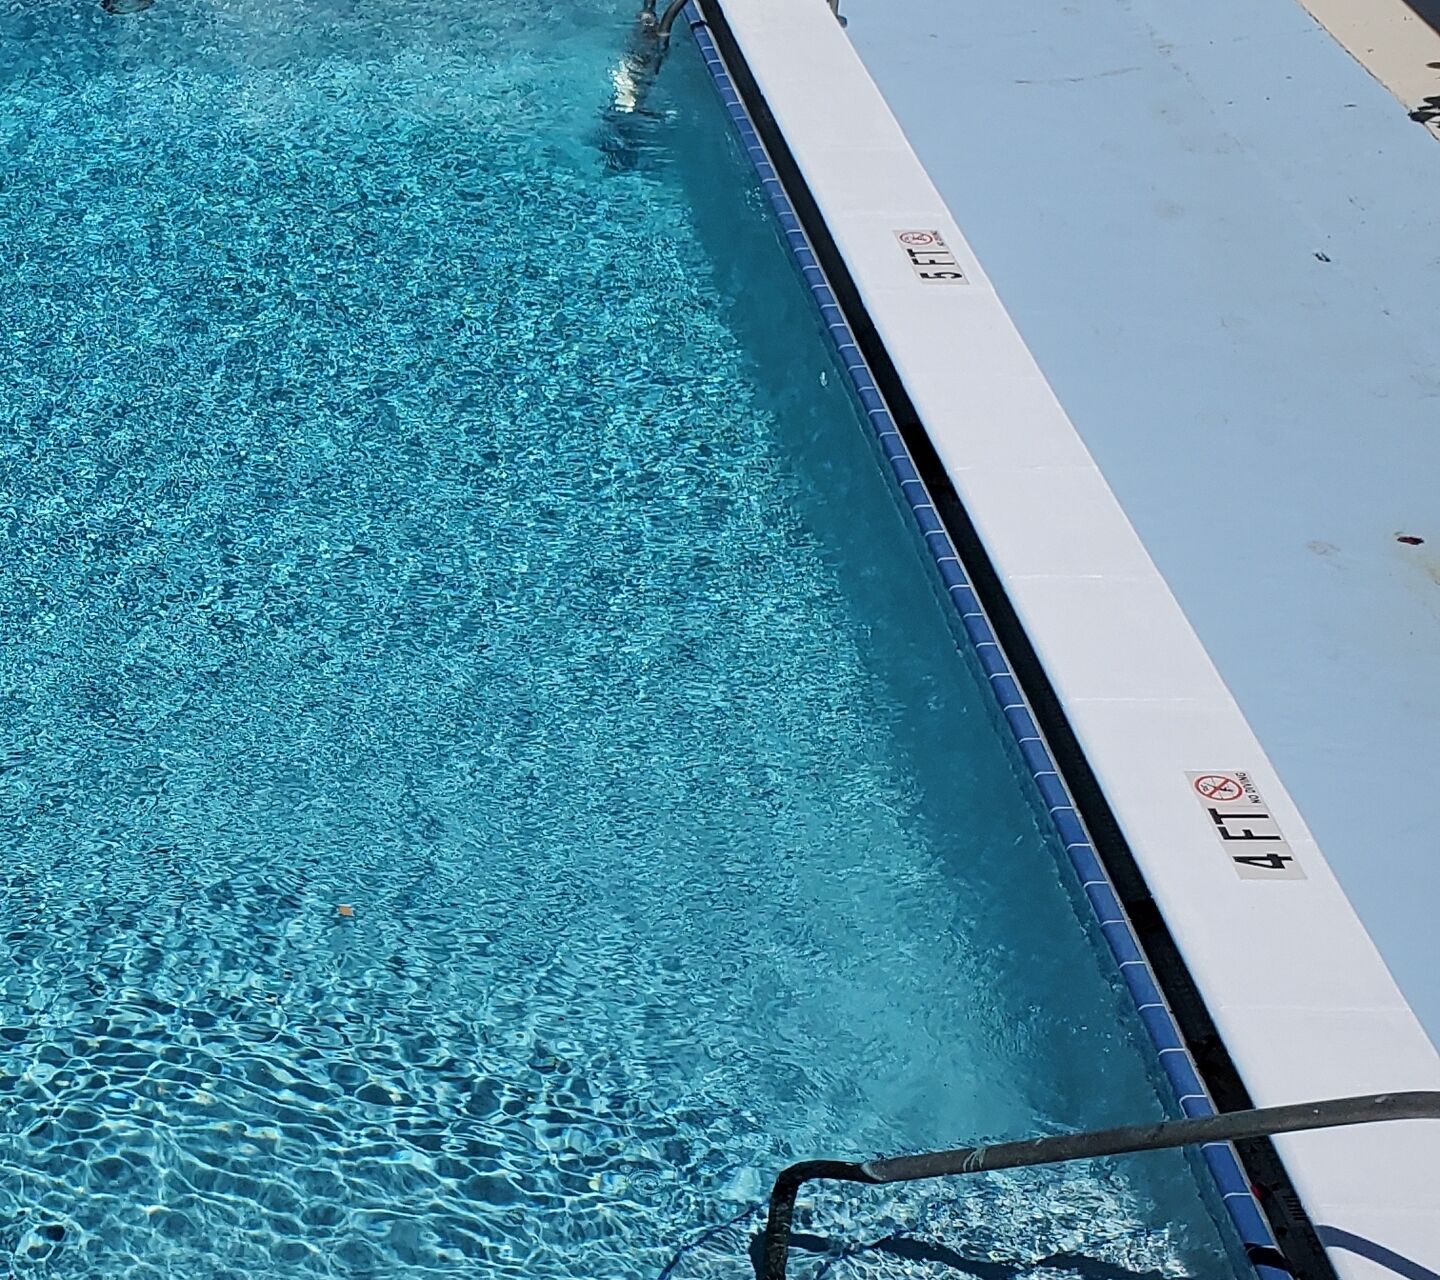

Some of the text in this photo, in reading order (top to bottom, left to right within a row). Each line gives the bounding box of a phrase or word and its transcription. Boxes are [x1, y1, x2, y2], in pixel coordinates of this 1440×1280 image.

[907, 248, 955, 265] FT
[1208, 808, 1293, 869] 4 FT
